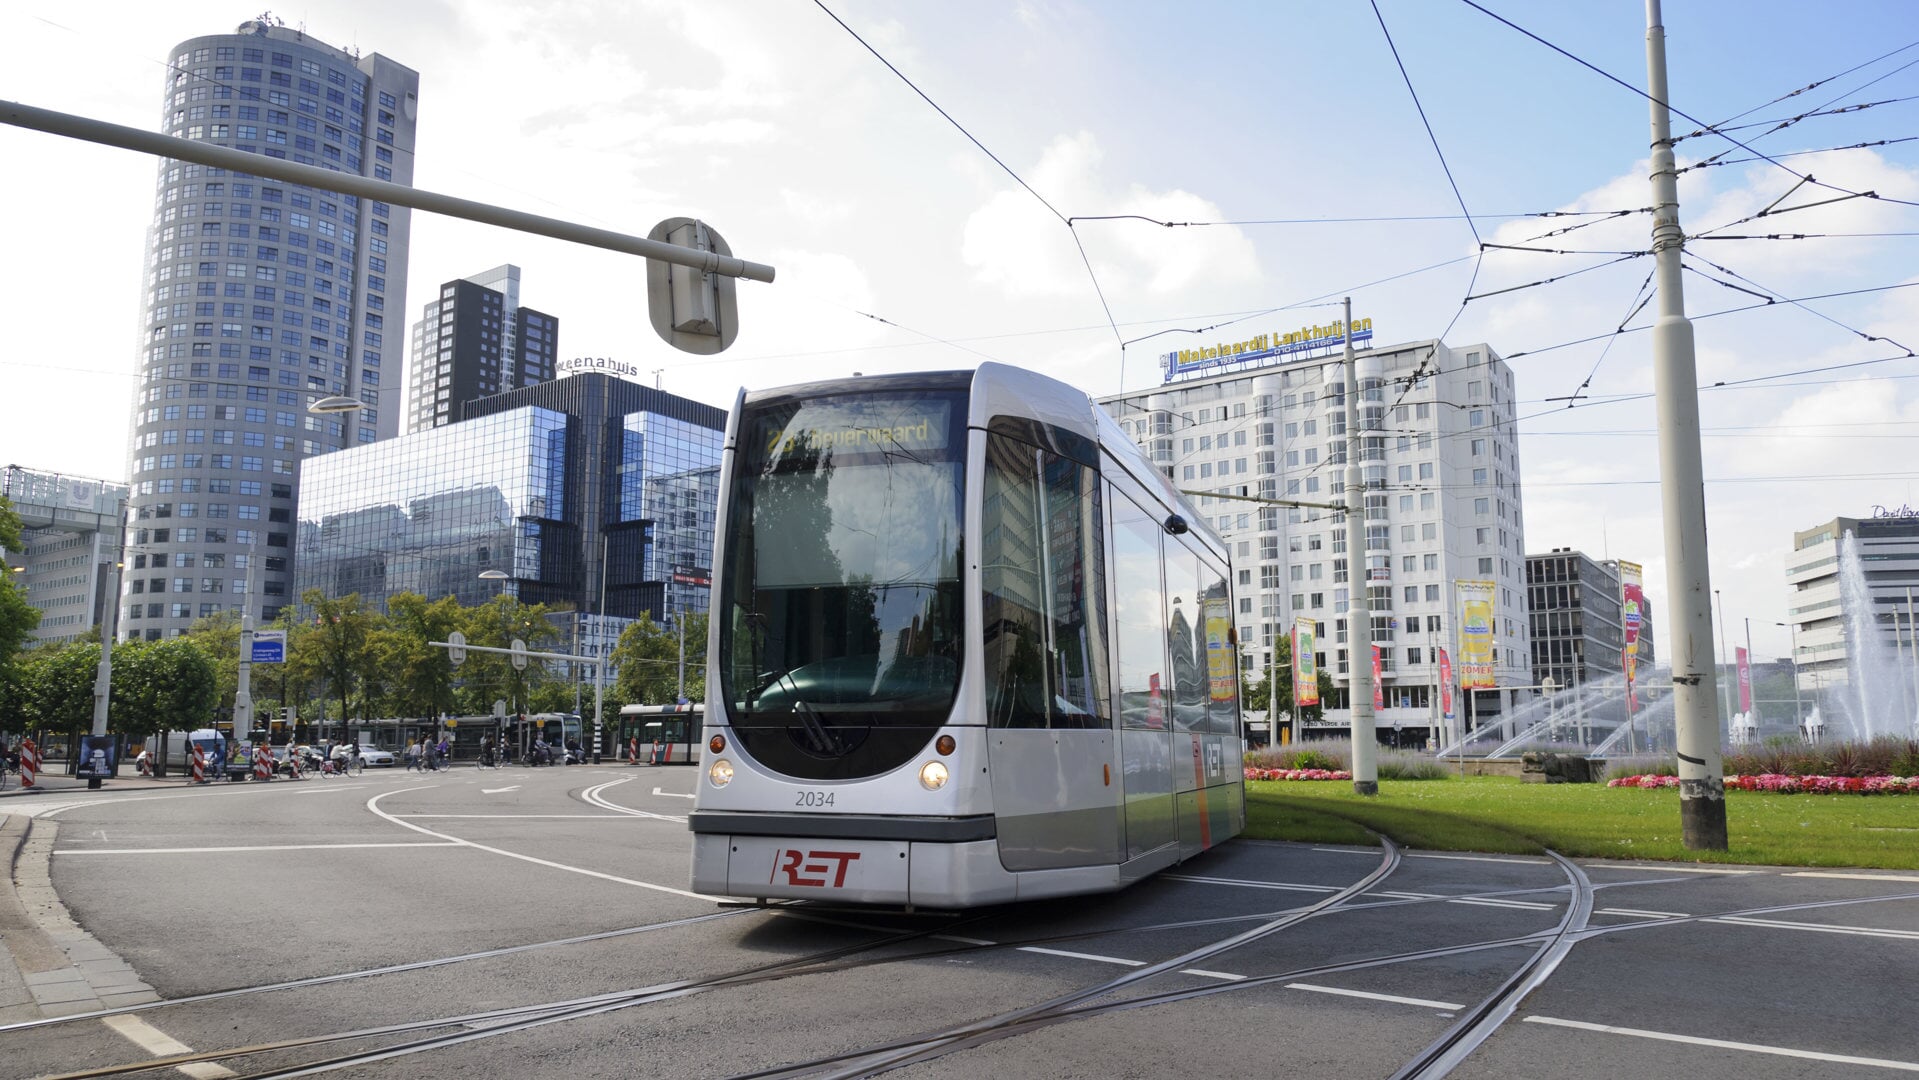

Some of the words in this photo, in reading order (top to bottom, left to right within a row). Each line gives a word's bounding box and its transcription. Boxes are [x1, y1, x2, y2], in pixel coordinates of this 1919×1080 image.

[1178, 333, 1268, 364] Makelaardij
[1273, 317, 1372, 347] Lankhuijen
[1199, 360, 1218, 369] sinds
[1461, 666, 1493, 675] ZOMER
[1207, 743, 1221, 778] RET
[795, 791, 835, 807] 2034
[781, 848, 861, 888] RET
